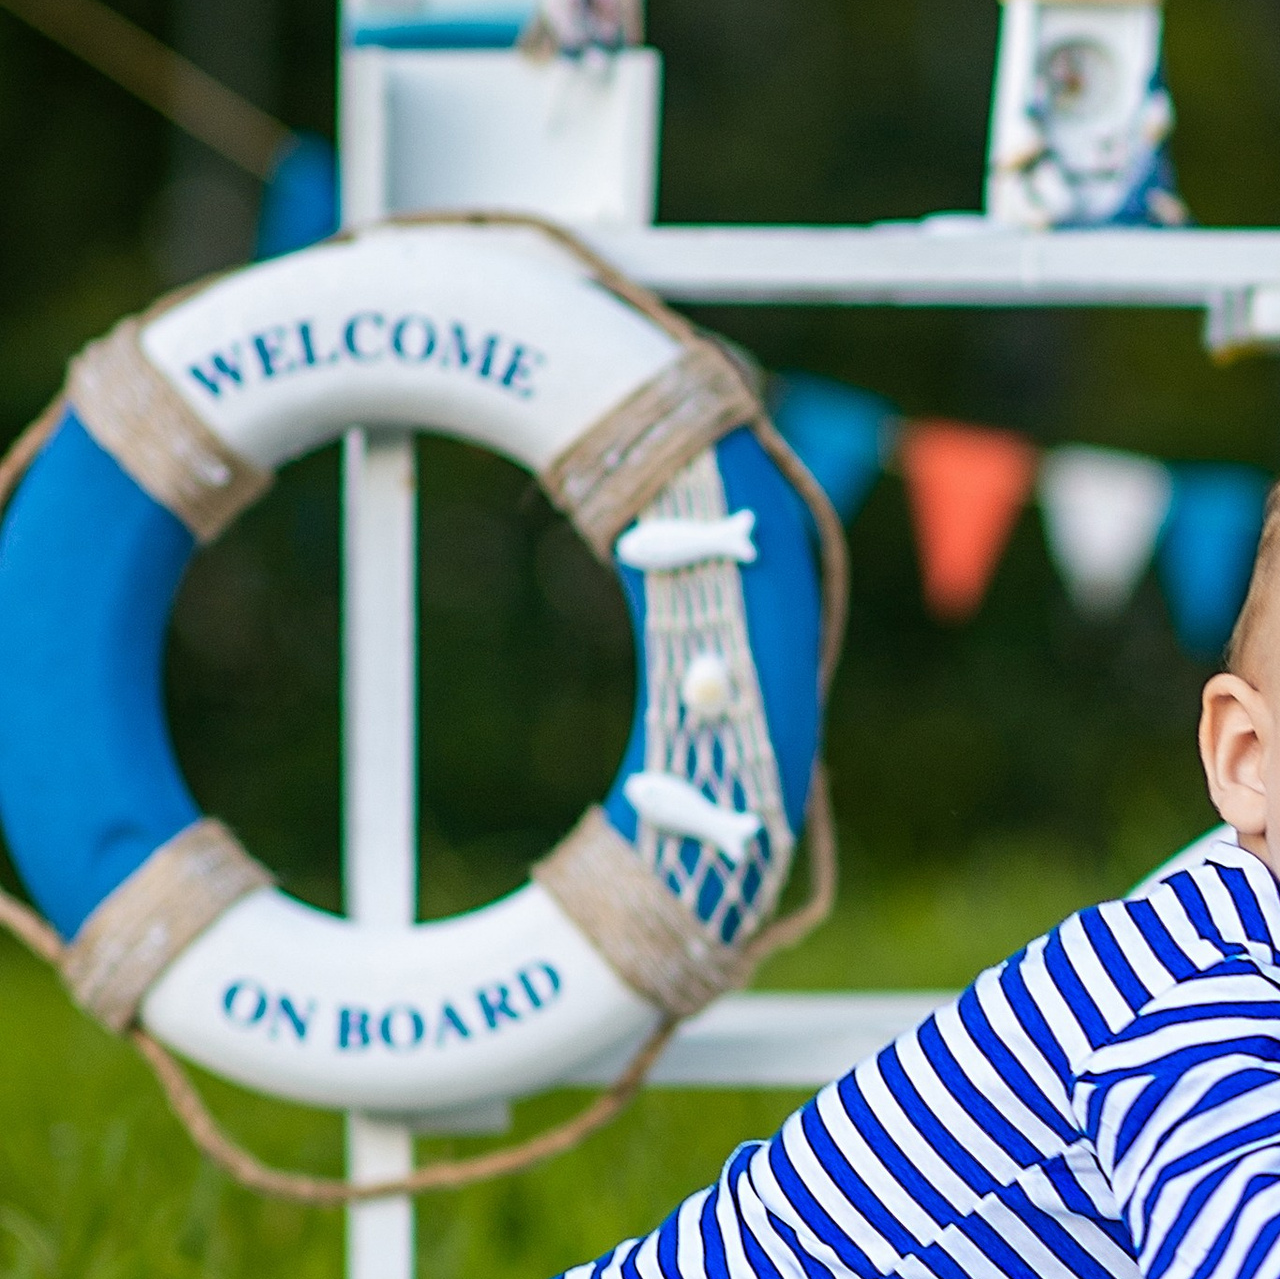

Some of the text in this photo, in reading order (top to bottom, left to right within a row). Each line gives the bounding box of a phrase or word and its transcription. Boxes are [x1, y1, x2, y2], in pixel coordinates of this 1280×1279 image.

[189, 312, 543, 398] WELCOME
[223, 962, 561, 1050] ON BOARD
